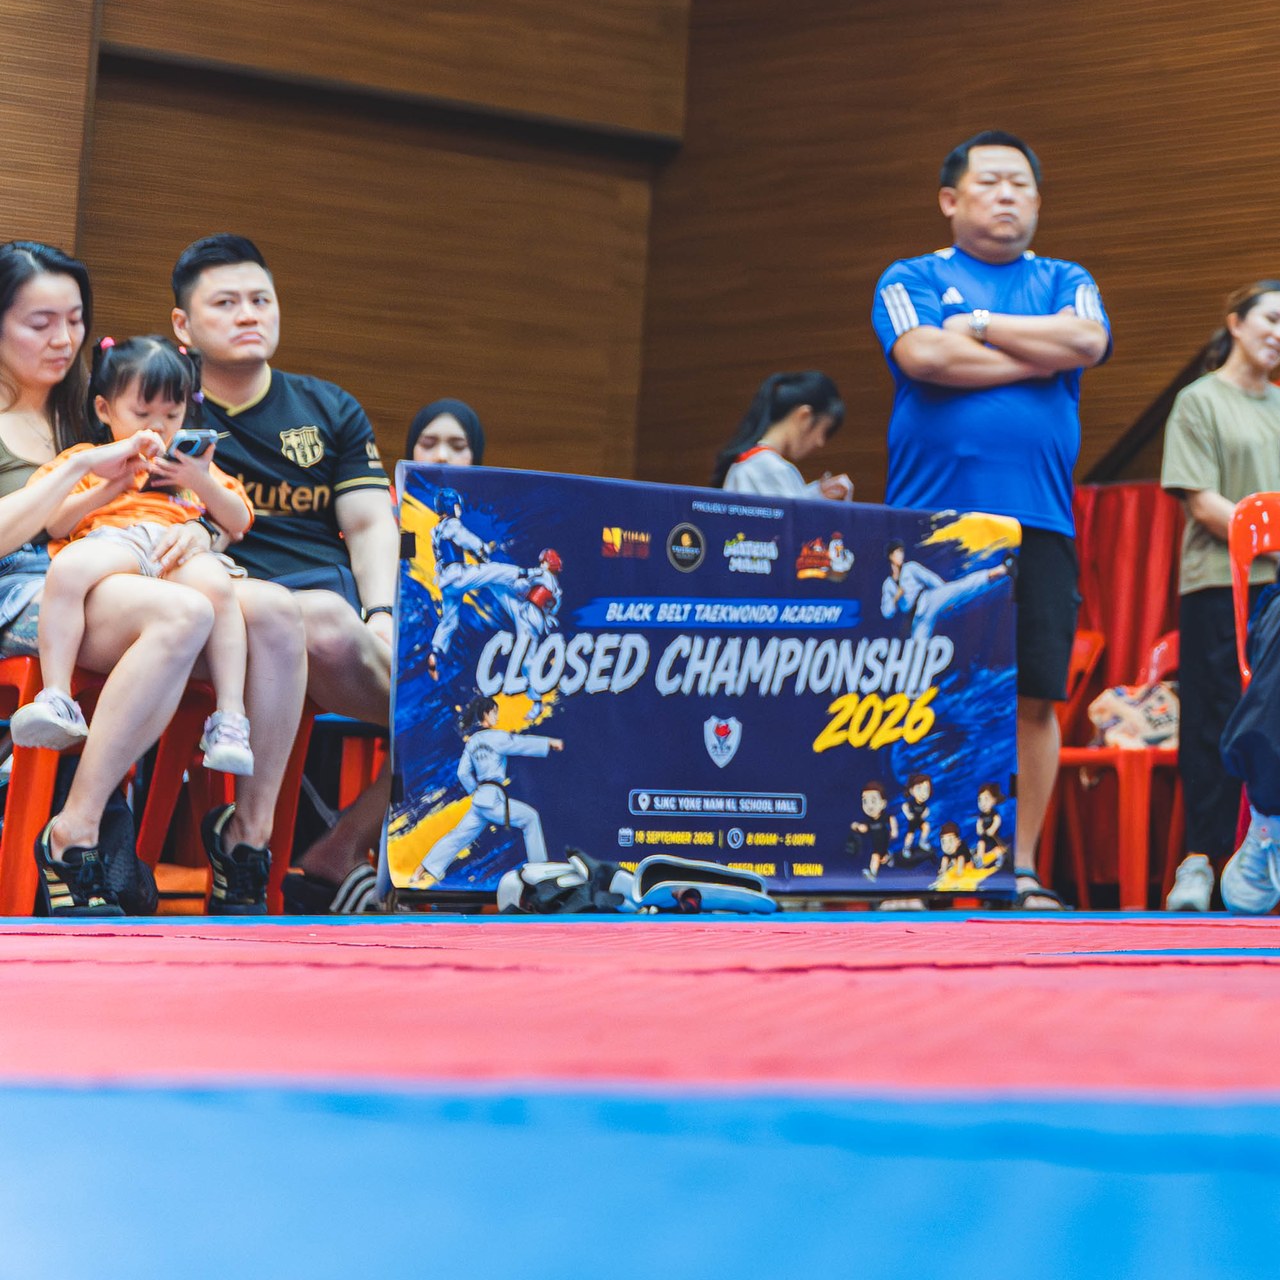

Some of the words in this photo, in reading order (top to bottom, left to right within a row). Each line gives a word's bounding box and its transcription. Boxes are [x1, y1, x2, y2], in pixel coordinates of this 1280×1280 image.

[606, 603, 654, 622] BLACK
[657, 603, 691, 623] BELT
[694, 604, 779, 624] TAEKWONDO
[780, 606, 842, 625] ACADEMY
[476, 630, 649, 696] CLOSED
[655, 634, 955, 699] CHAMPIONSHIP
[812, 686, 939, 753] 2026
[653, 796, 677, 810] SJKC
[678, 797, 701, 811] YOKE
[703, 797, 724, 812] NAM
[739, 798, 773, 813] SCHOOL
[774, 799, 799, 813] HALL
[646, 831, 692, 844] SEPTEMBER
